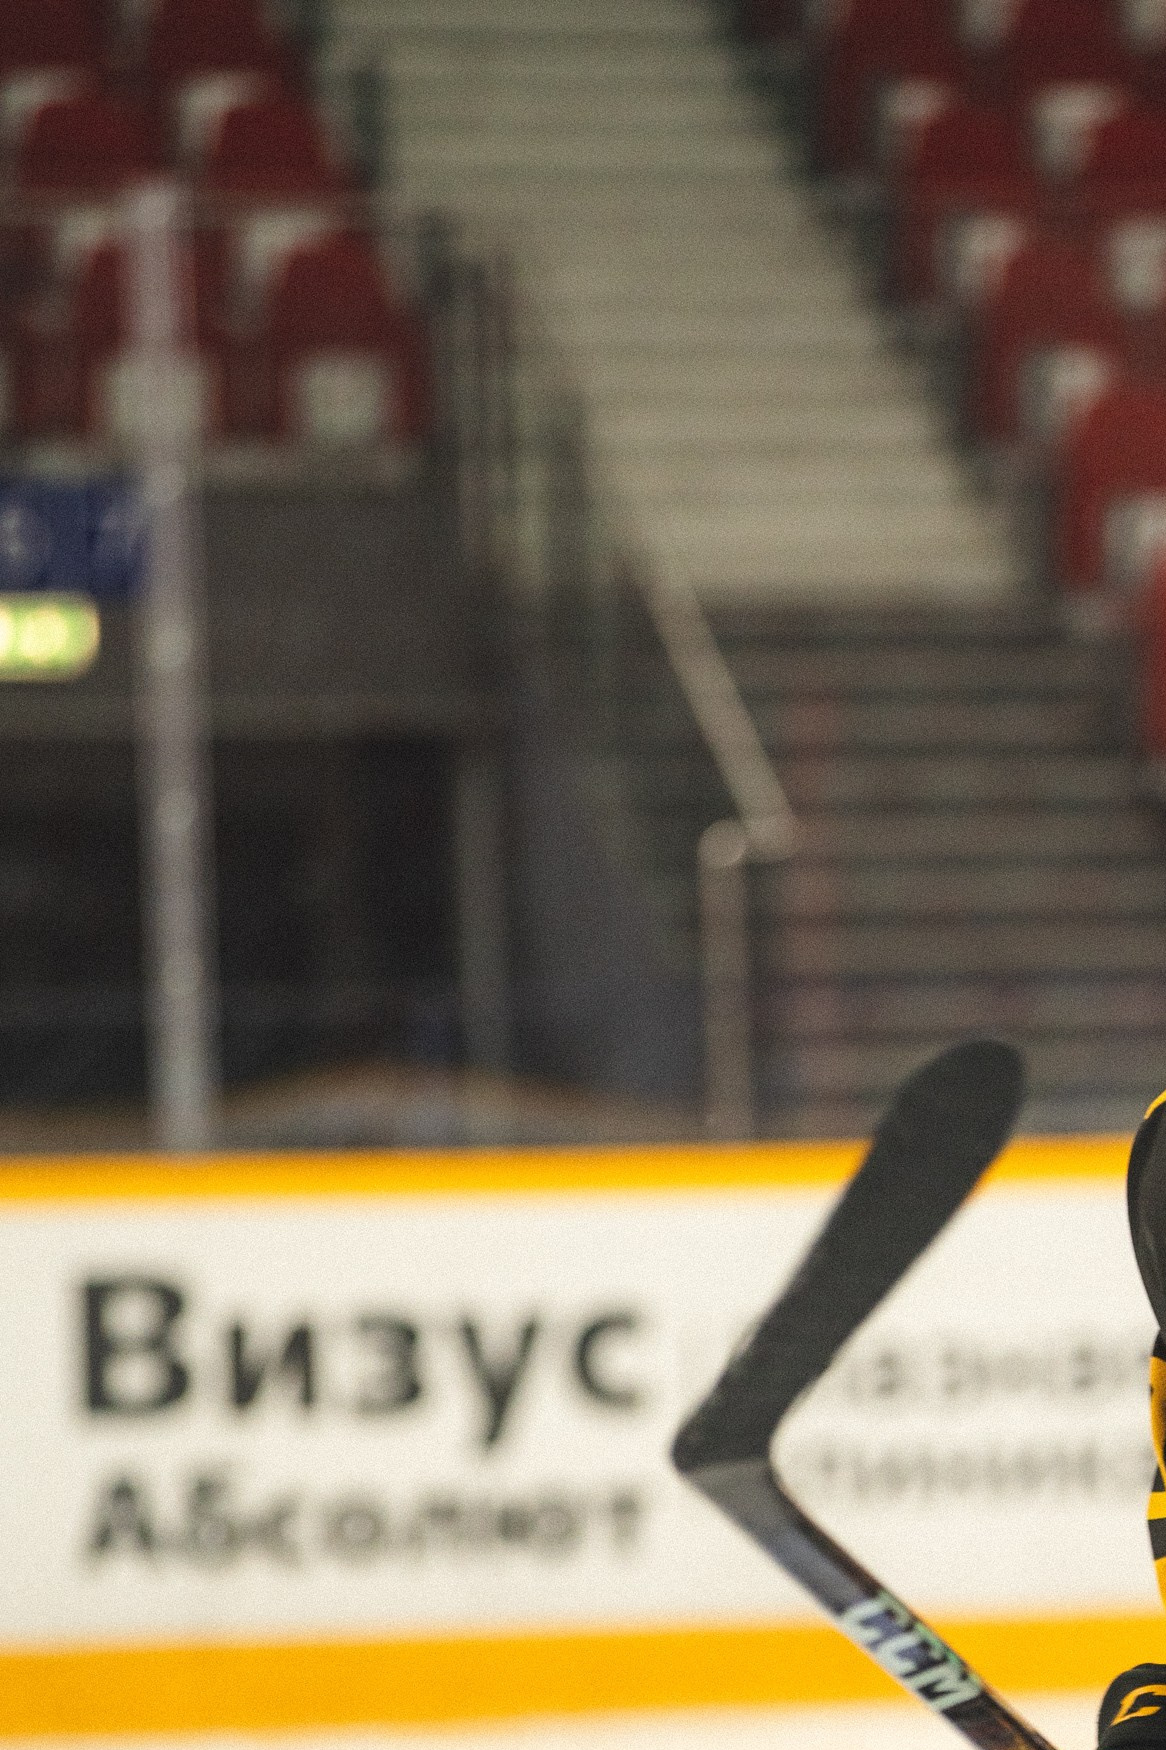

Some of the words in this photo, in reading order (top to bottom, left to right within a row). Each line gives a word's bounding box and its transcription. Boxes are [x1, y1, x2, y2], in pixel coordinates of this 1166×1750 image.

[76, 1270, 650, 1448] Визус
[88, 1466, 648, 1566] Абсолют
[840, 1591, 984, 1712] CCM
